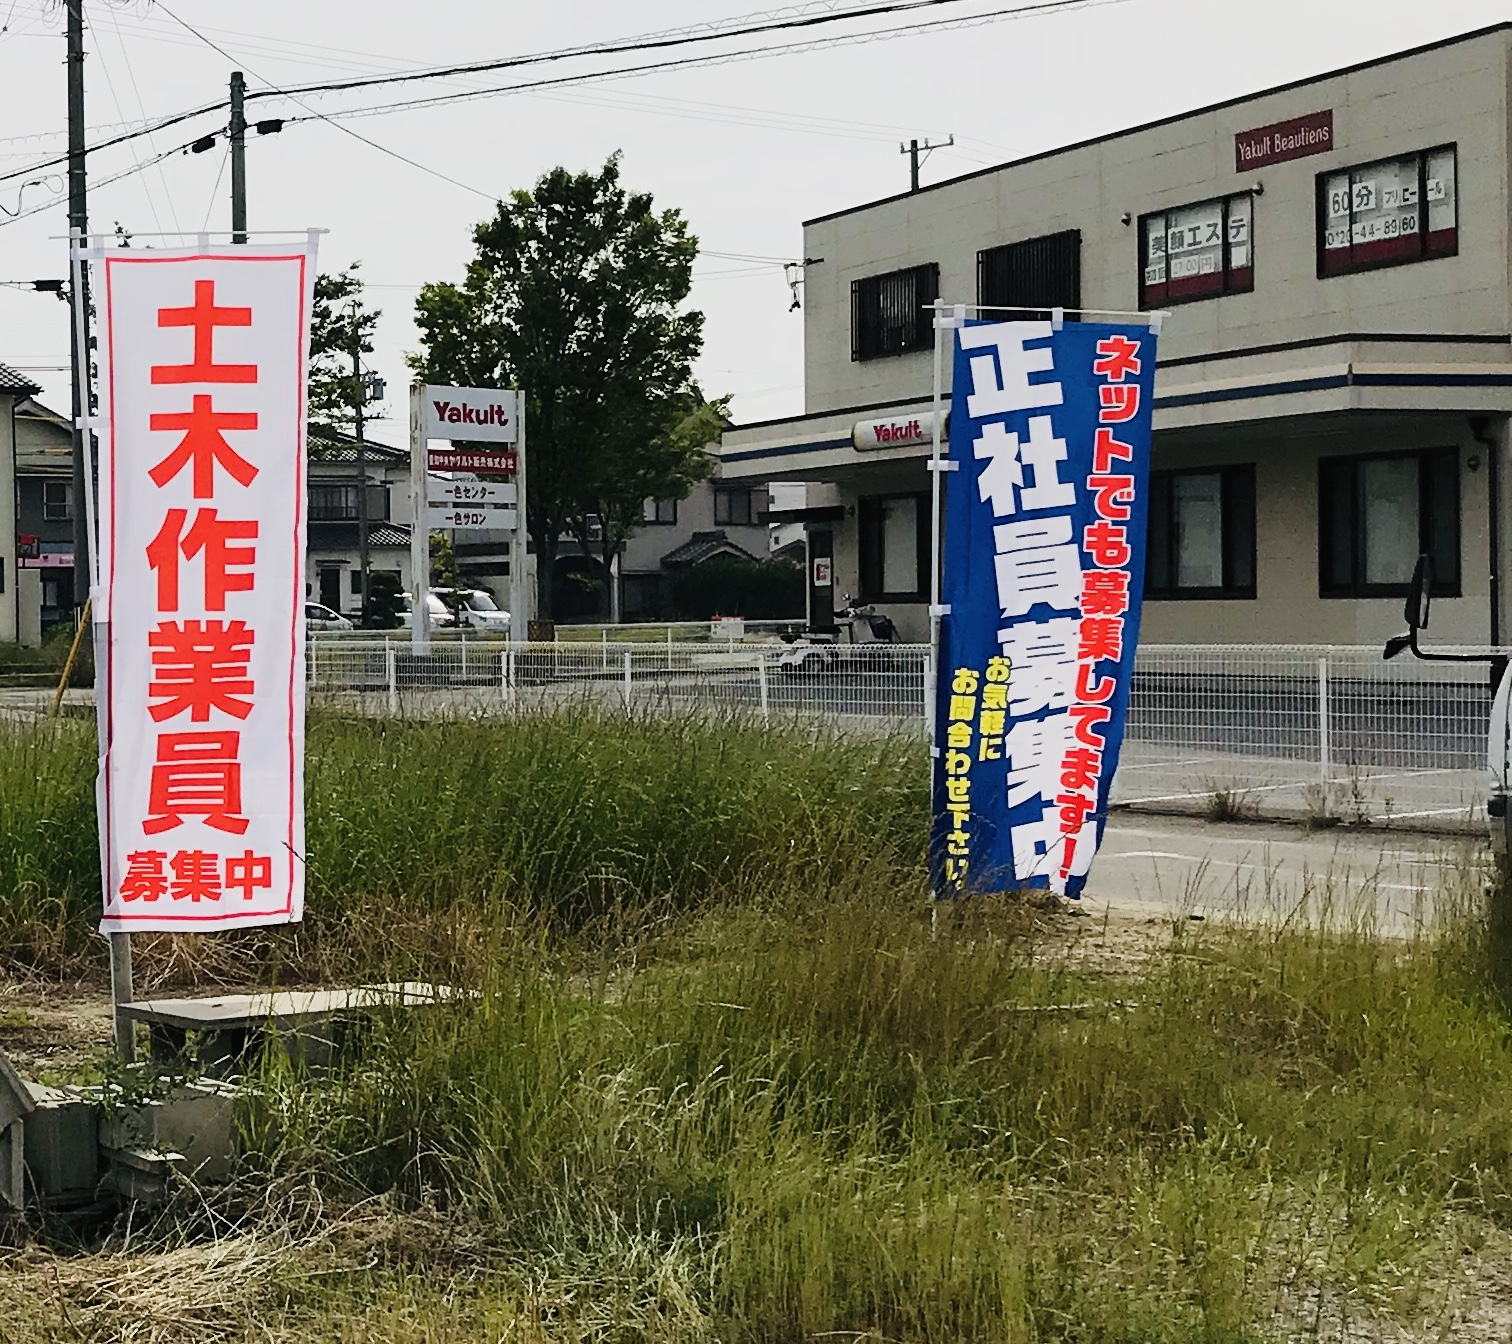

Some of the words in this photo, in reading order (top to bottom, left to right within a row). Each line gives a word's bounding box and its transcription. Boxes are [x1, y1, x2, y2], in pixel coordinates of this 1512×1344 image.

[1238, 136, 1271, 161] Yakult
[1274, 126, 1329, 153] Beautiens
[1151, 218, 1246, 256] 美顔エステ
[433, 400, 509, 427] Yakult
[873, 419, 922, 442] Yakult
[445, 485, 495, 499] 一色センター
[445, 512, 486, 526] 一色サロン
[142, 280, 259, 836] 土木作業員
[958, 320, 1097, 900] 正社員募集中
[1053, 334, 1141, 880] ネットでも募集してます!
[979, 655, 1012, 762] お気軽に
[120, 850, 272, 903] 募集中
